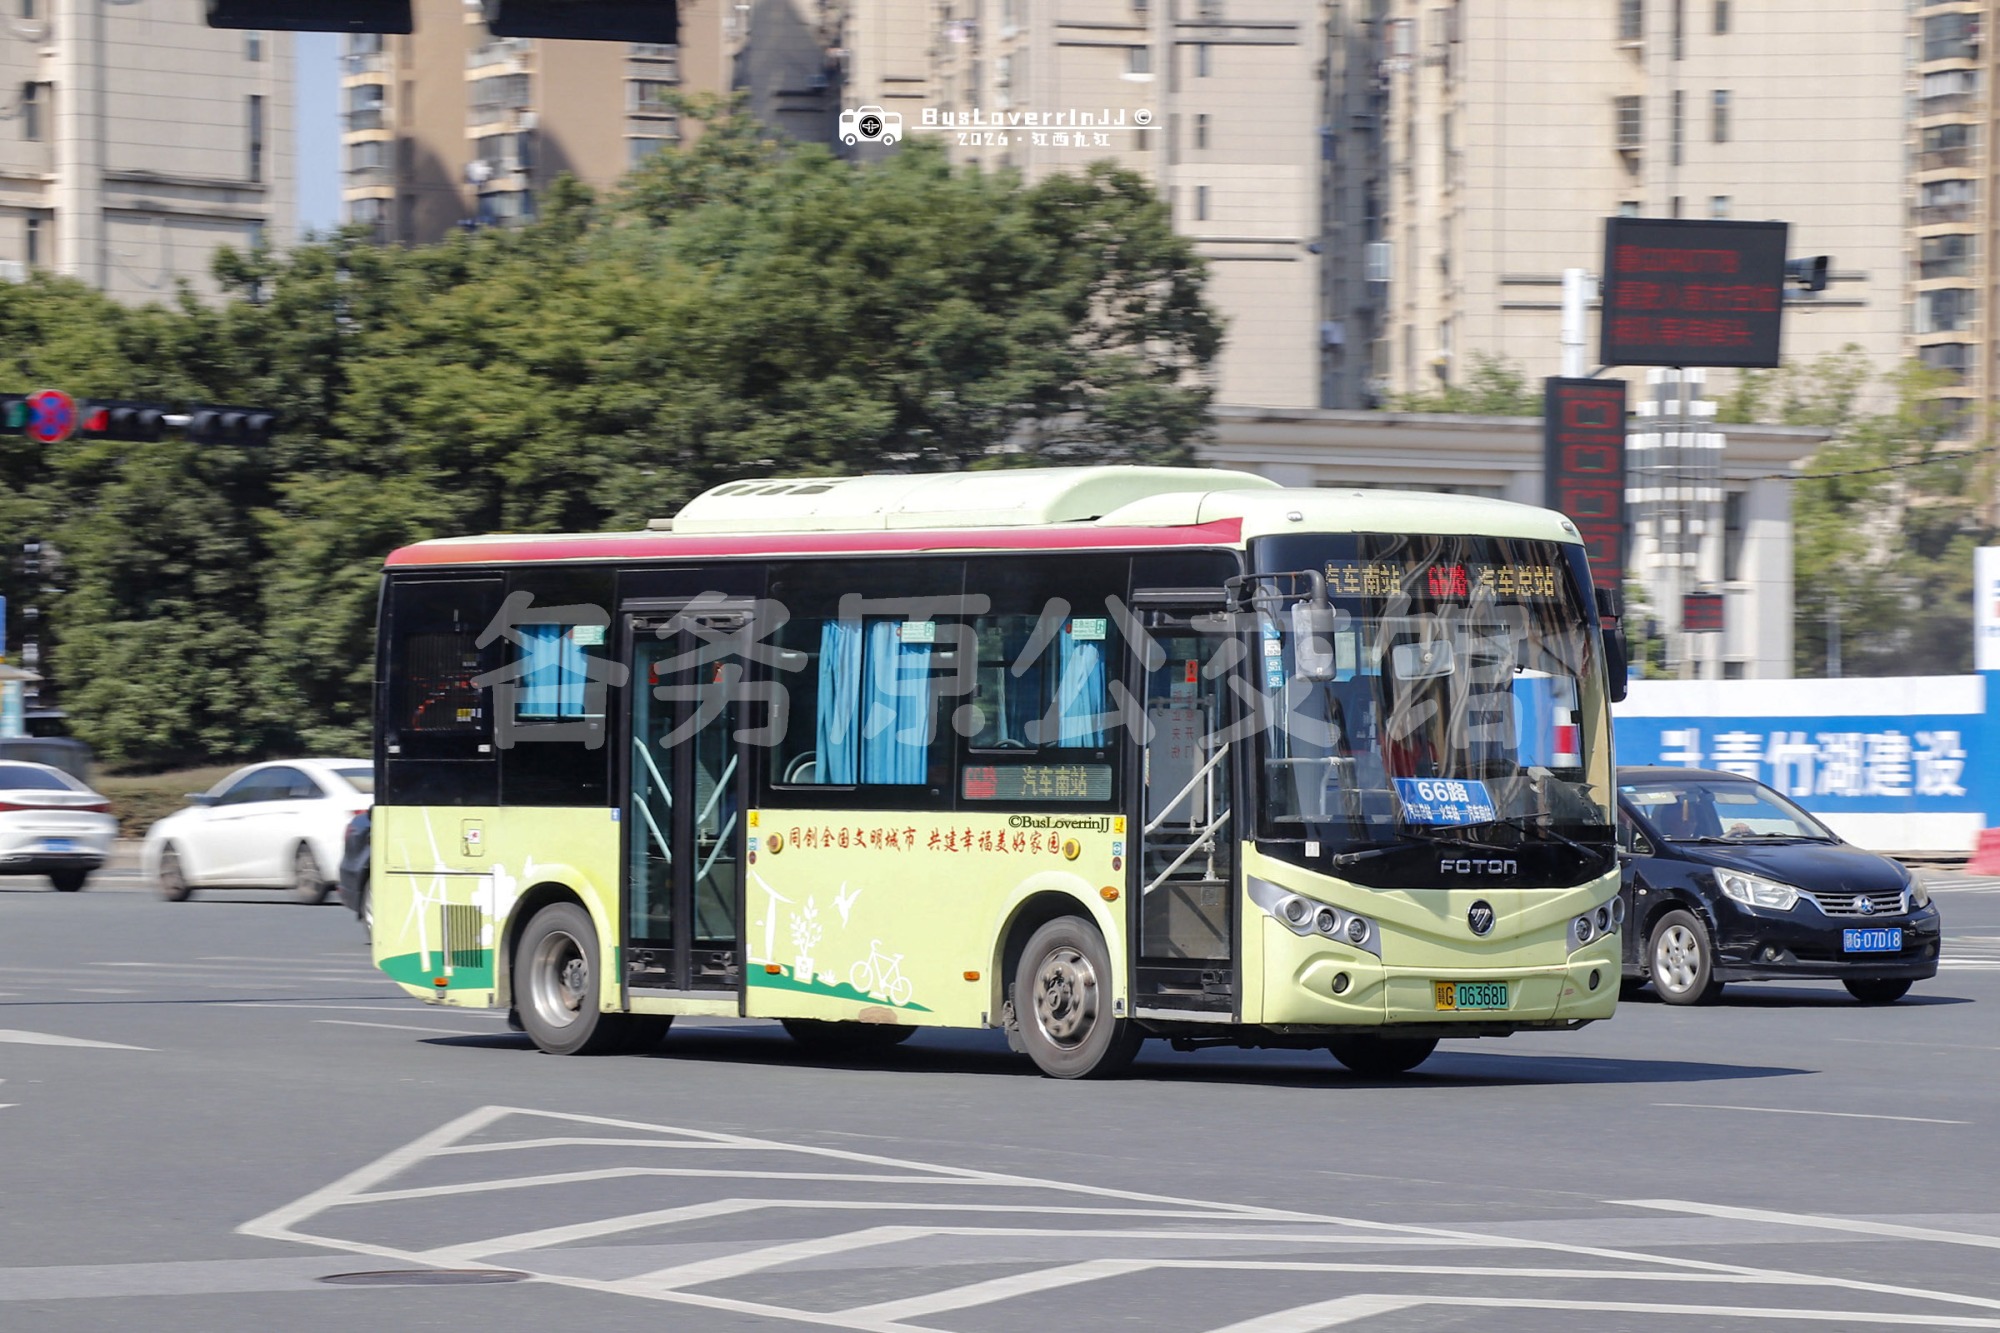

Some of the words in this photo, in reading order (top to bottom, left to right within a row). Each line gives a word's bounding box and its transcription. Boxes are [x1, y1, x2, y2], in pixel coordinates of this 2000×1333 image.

[1325, 563, 1401, 595] 汽车南站
[1477, 565, 1555, 597] 汽车总站
[1020, 765, 1087, 797] 汽车南站
[1418, 782, 1469, 802] 66路
[788, 826, 917, 852] 同创全国文明城市
[927, 826, 1060, 855] 共建幸福美好家园
[1440, 859, 1517, 875] FOTON
